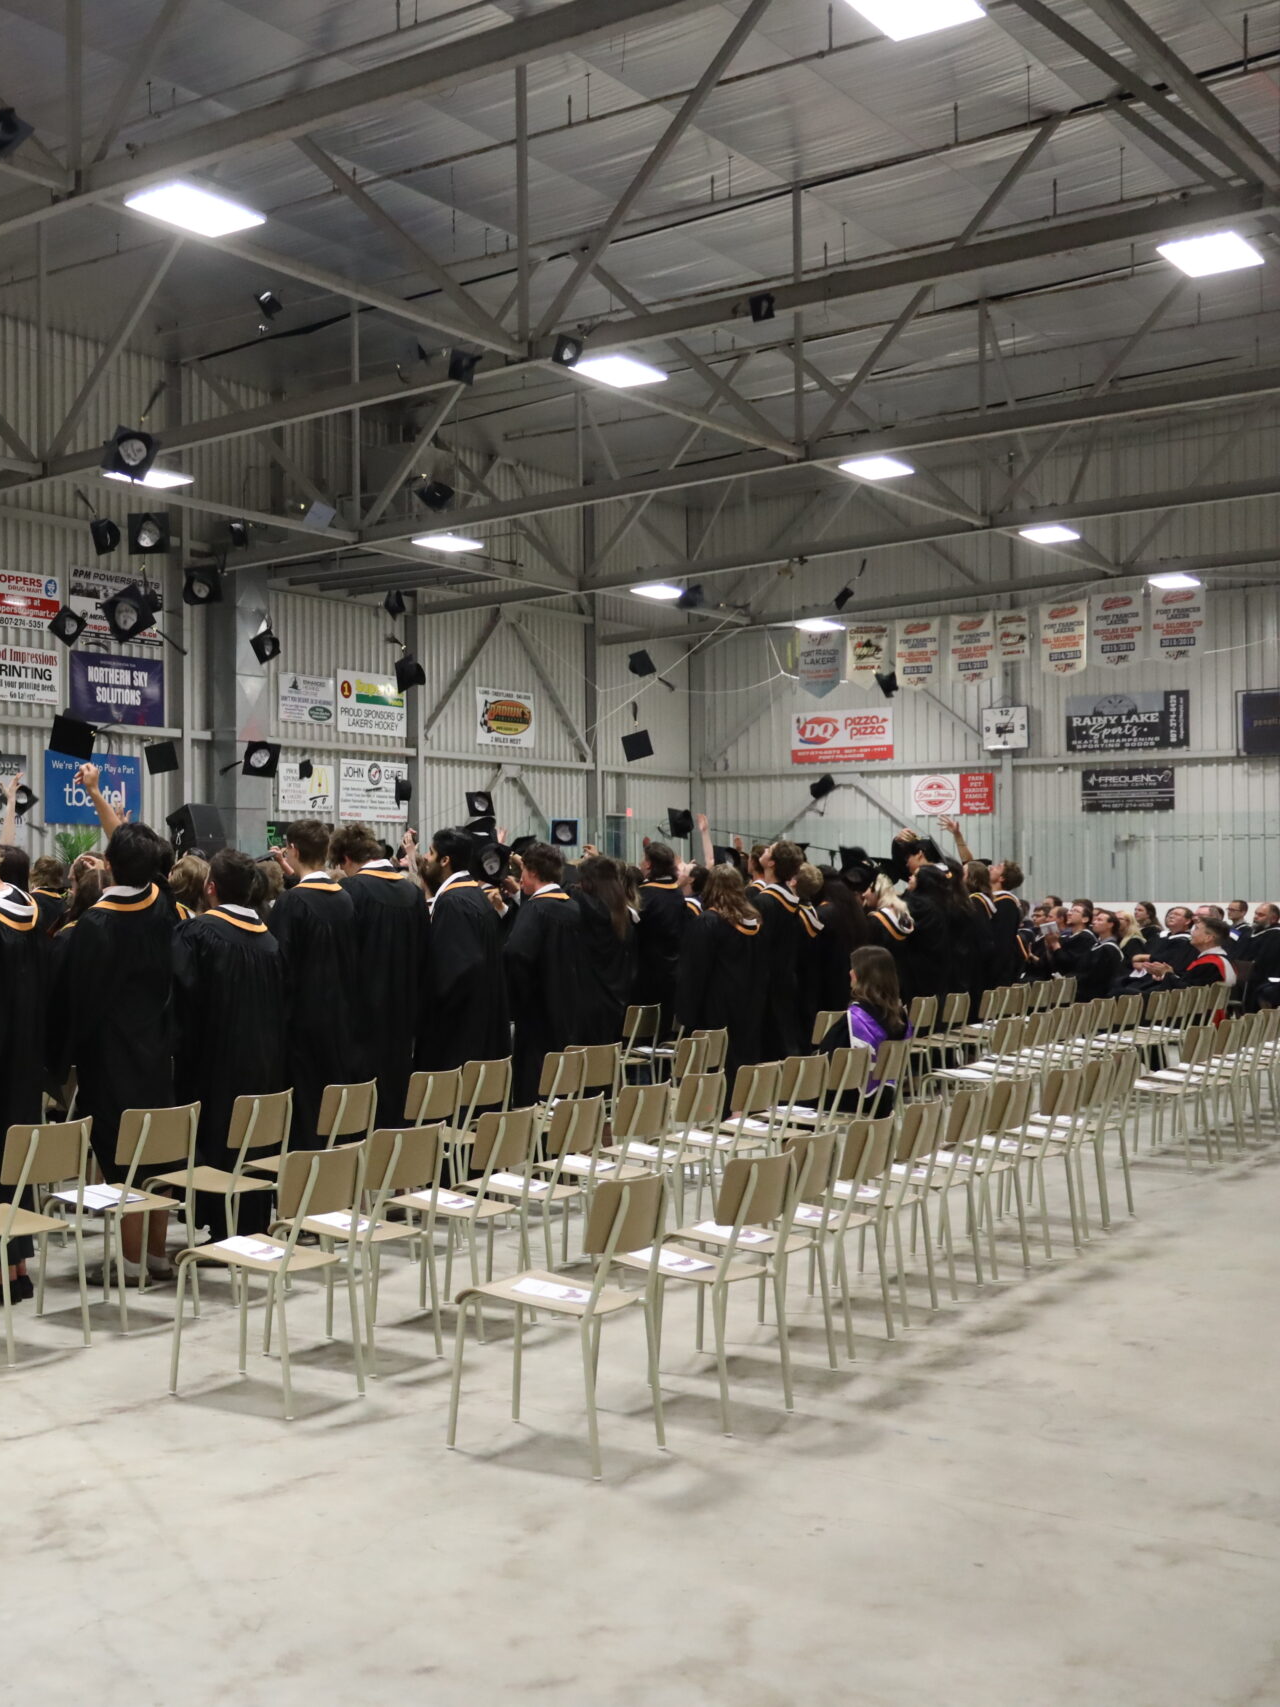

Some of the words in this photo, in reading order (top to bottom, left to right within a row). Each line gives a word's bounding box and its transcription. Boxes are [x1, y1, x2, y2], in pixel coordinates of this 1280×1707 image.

[72, 568, 91, 579] RPM
[0, 616, 44, 629] 807-274-5351
[1093, 628, 1119, 636] REGULAR
[10, 648, 58, 667] Impressions
[804, 656, 837, 665] LAKERS
[87, 665, 131, 686] NORTHERN
[132, 670, 149, 687] SKY
[5, 680, 17, 688] your
[18, 681, 40, 691] printing
[343, 682, 350, 696] 1
[96, 686, 141, 706] SOLUTIONS
[340, 706, 362, 718] PROUD
[363, 708, 395, 720] SPONSORS
[396, 712, 404, 721] OF
[1072, 715, 1120, 727] RAINY
[1120, 712, 1160, 724] LAKE
[374, 720, 399, 731] HOCKEY
[804, 722, 835, 739] DQ
[844, 715, 881, 730] pizza
[849, 725, 886, 740] pizza
[1089, 722, 1142, 740] Sports
[51, 760, 73, 770] We're
[104, 763, 117, 775] Play
[122, 765, 135, 774] Part
[343, 766, 364, 778] JOHN
[1099, 774, 1164, 783] FREQUENCY
